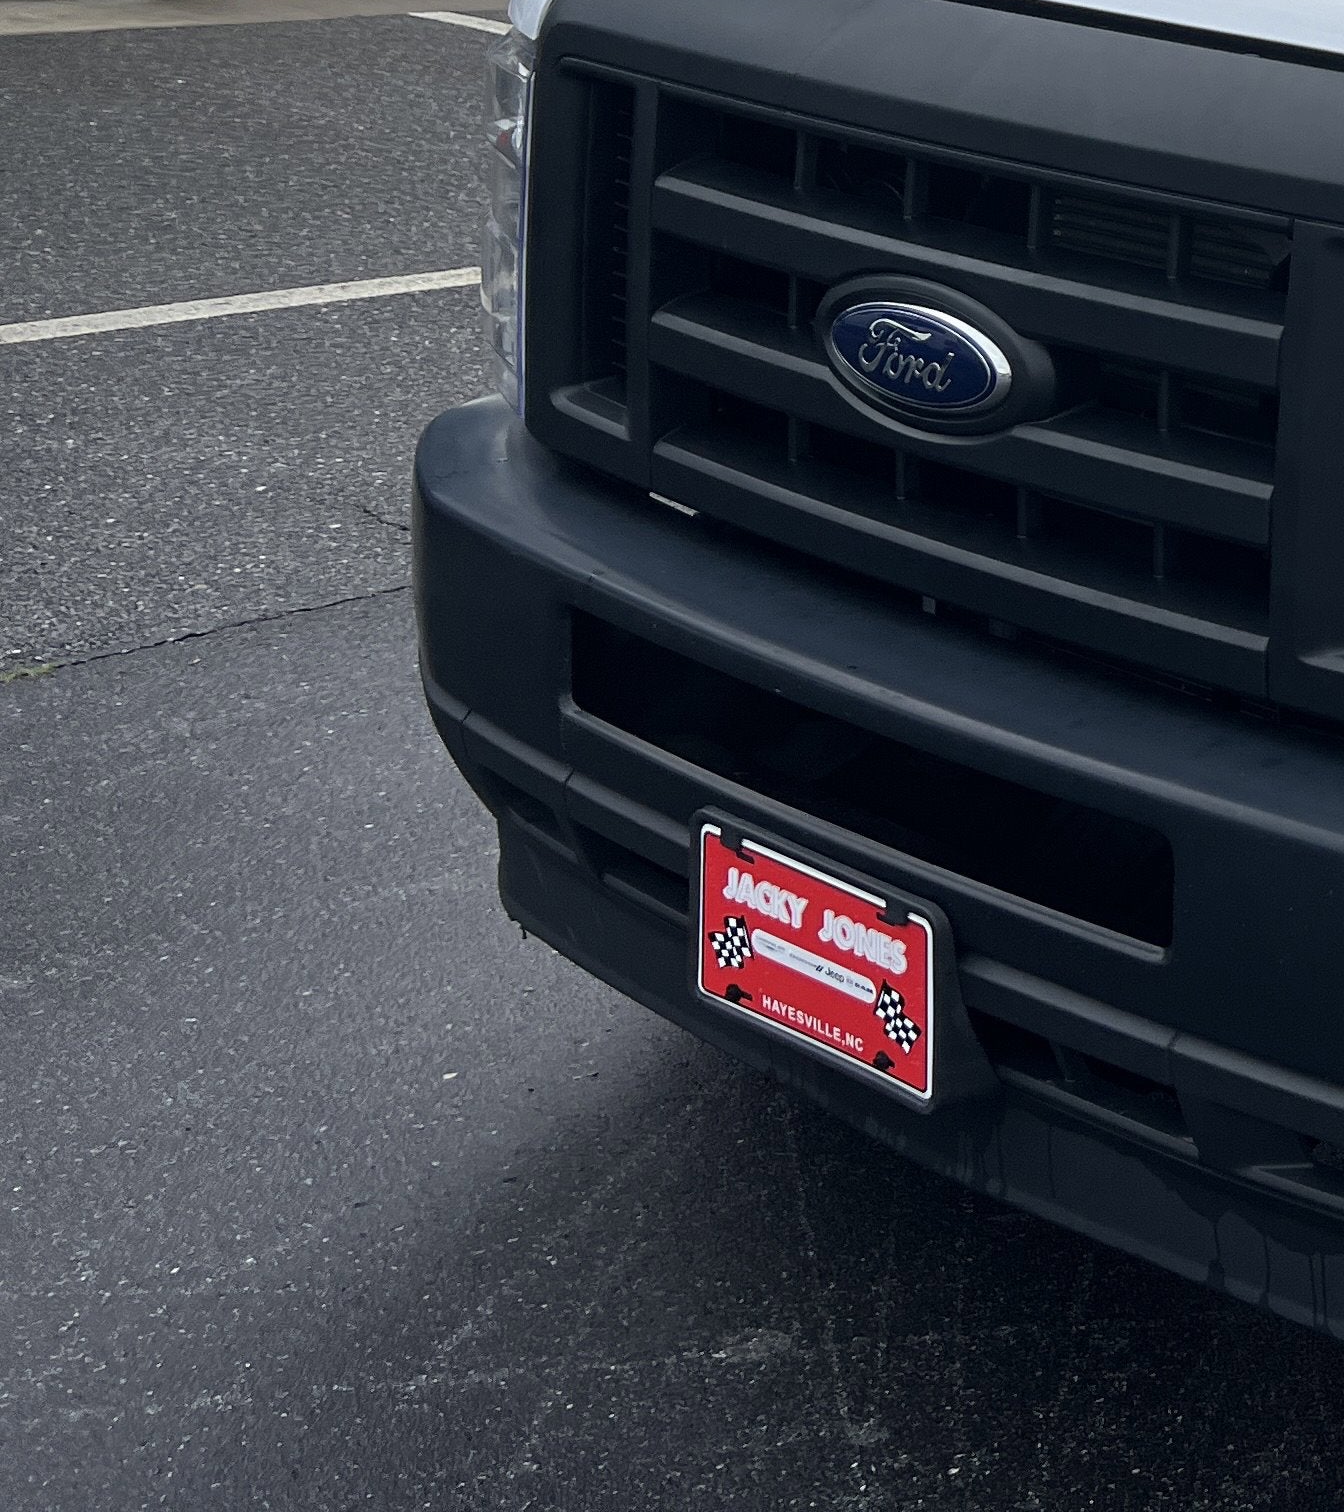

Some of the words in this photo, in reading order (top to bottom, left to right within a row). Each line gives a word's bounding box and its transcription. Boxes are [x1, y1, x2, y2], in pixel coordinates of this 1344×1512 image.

[858, 319, 954, 391] Ford
[722, 866, 809, 929] JACKY
[817, 908, 908, 975] JONES
